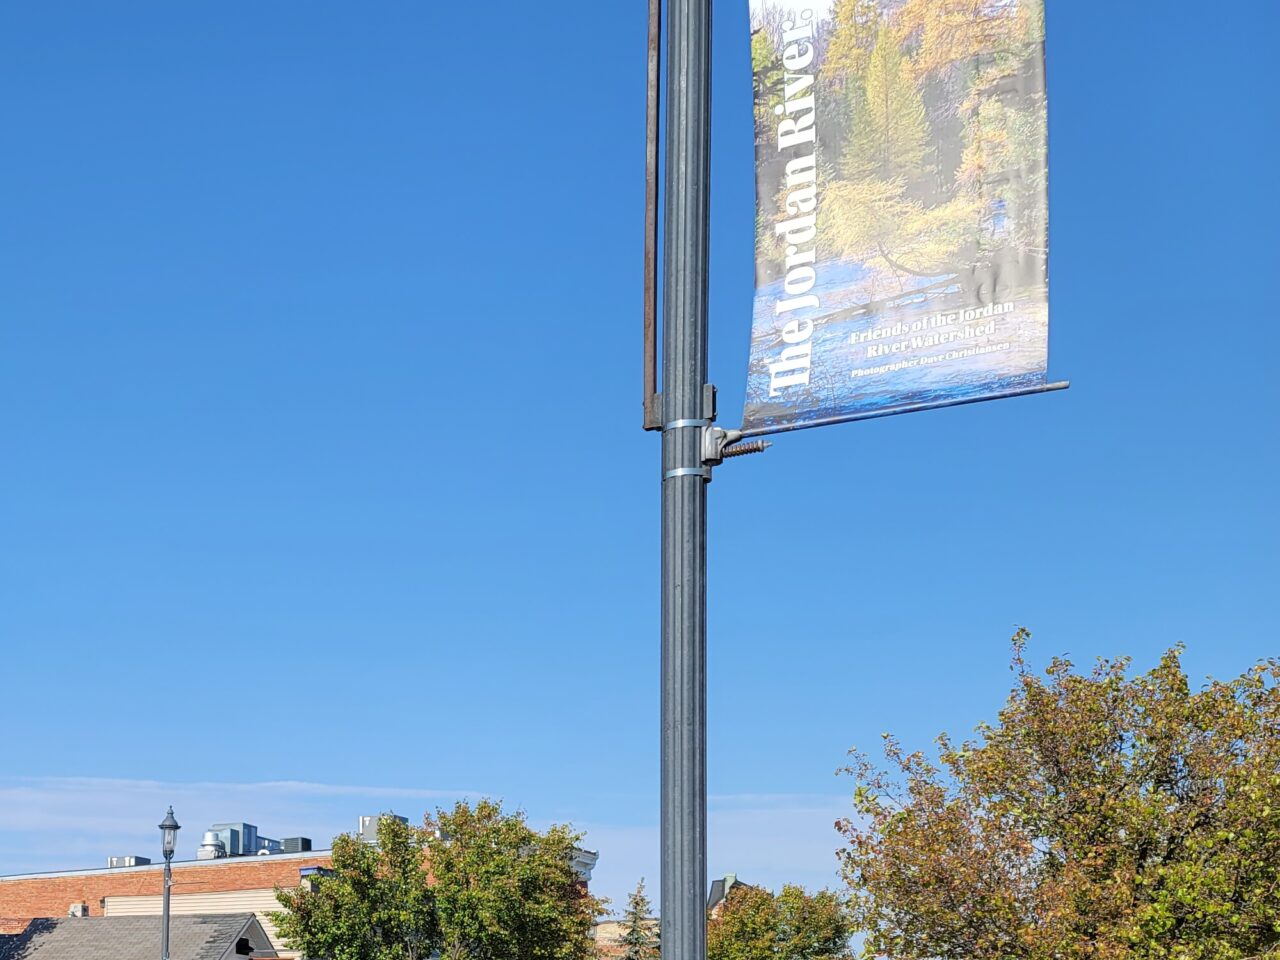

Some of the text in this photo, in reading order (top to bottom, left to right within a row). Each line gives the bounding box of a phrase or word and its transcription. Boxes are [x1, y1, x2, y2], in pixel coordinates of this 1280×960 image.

[775, 152, 820, 317] Jordan
[849, 301, 1015, 345] Friends of the Jordan
[866, 321, 996, 359] River Watershed
[768, 318, 814, 398] The
[851, 342, 1010, 378] Photographer Dave Christiansen
